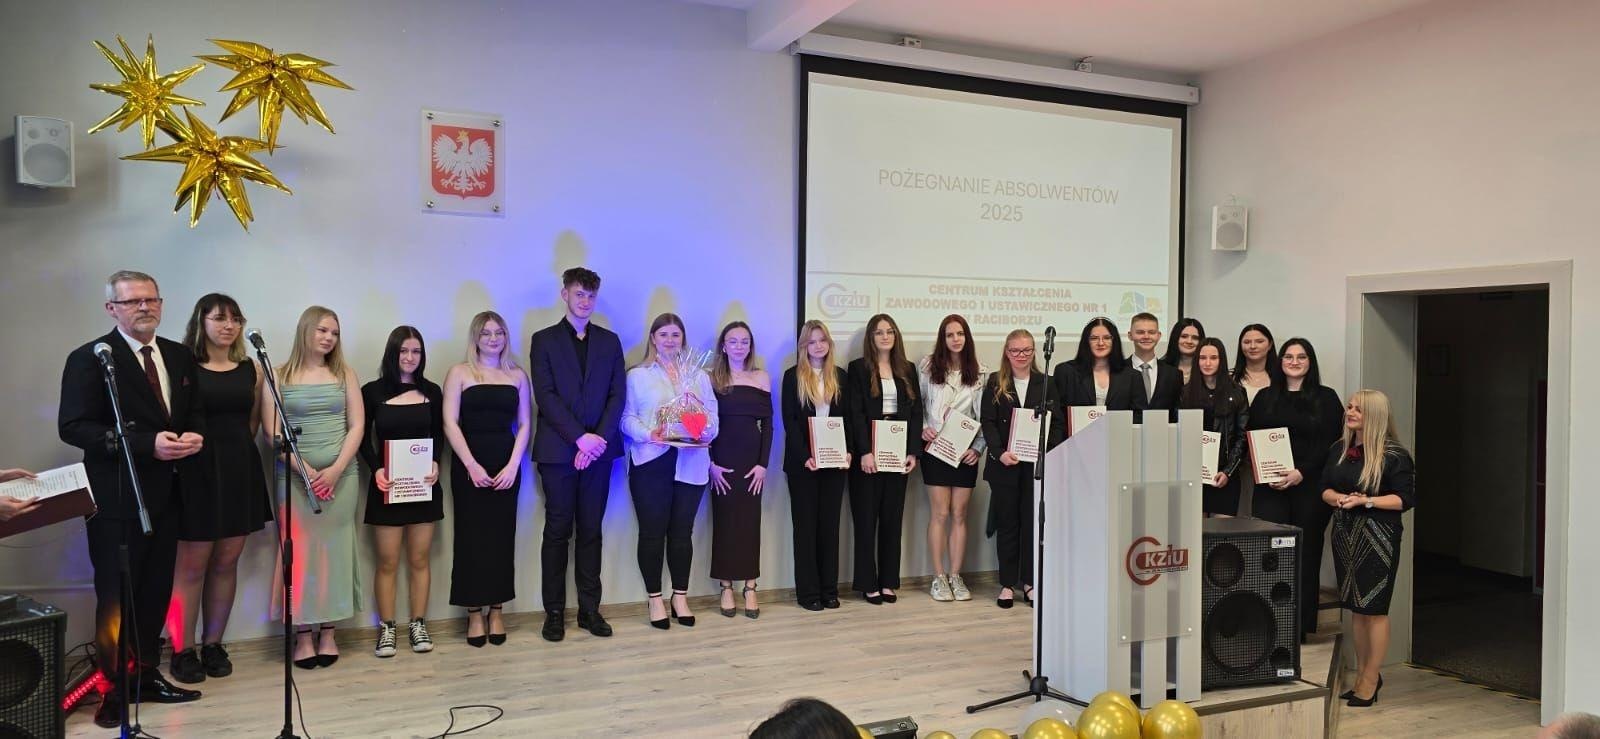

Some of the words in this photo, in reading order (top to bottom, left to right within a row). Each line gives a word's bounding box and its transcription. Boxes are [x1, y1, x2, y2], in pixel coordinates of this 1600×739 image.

[879, 168, 990, 193] POŻEGNANIE
[994, 180, 1119, 204] ABSOLWENTÓW
[980, 203, 1023, 221] 2025
[928, 284, 988, 296] CENTRUM
[992, 286, 1072, 298] KSZTAŁCENIA
[885, 297, 976, 310] ZAWODOWEGO
[988, 301, 1079, 312] USTAWICZNEGO
[1083, 303, 1098, 313] NR
[1101, 303, 1107, 313] 1
[974, 315, 1042, 325] RACIBORZU
